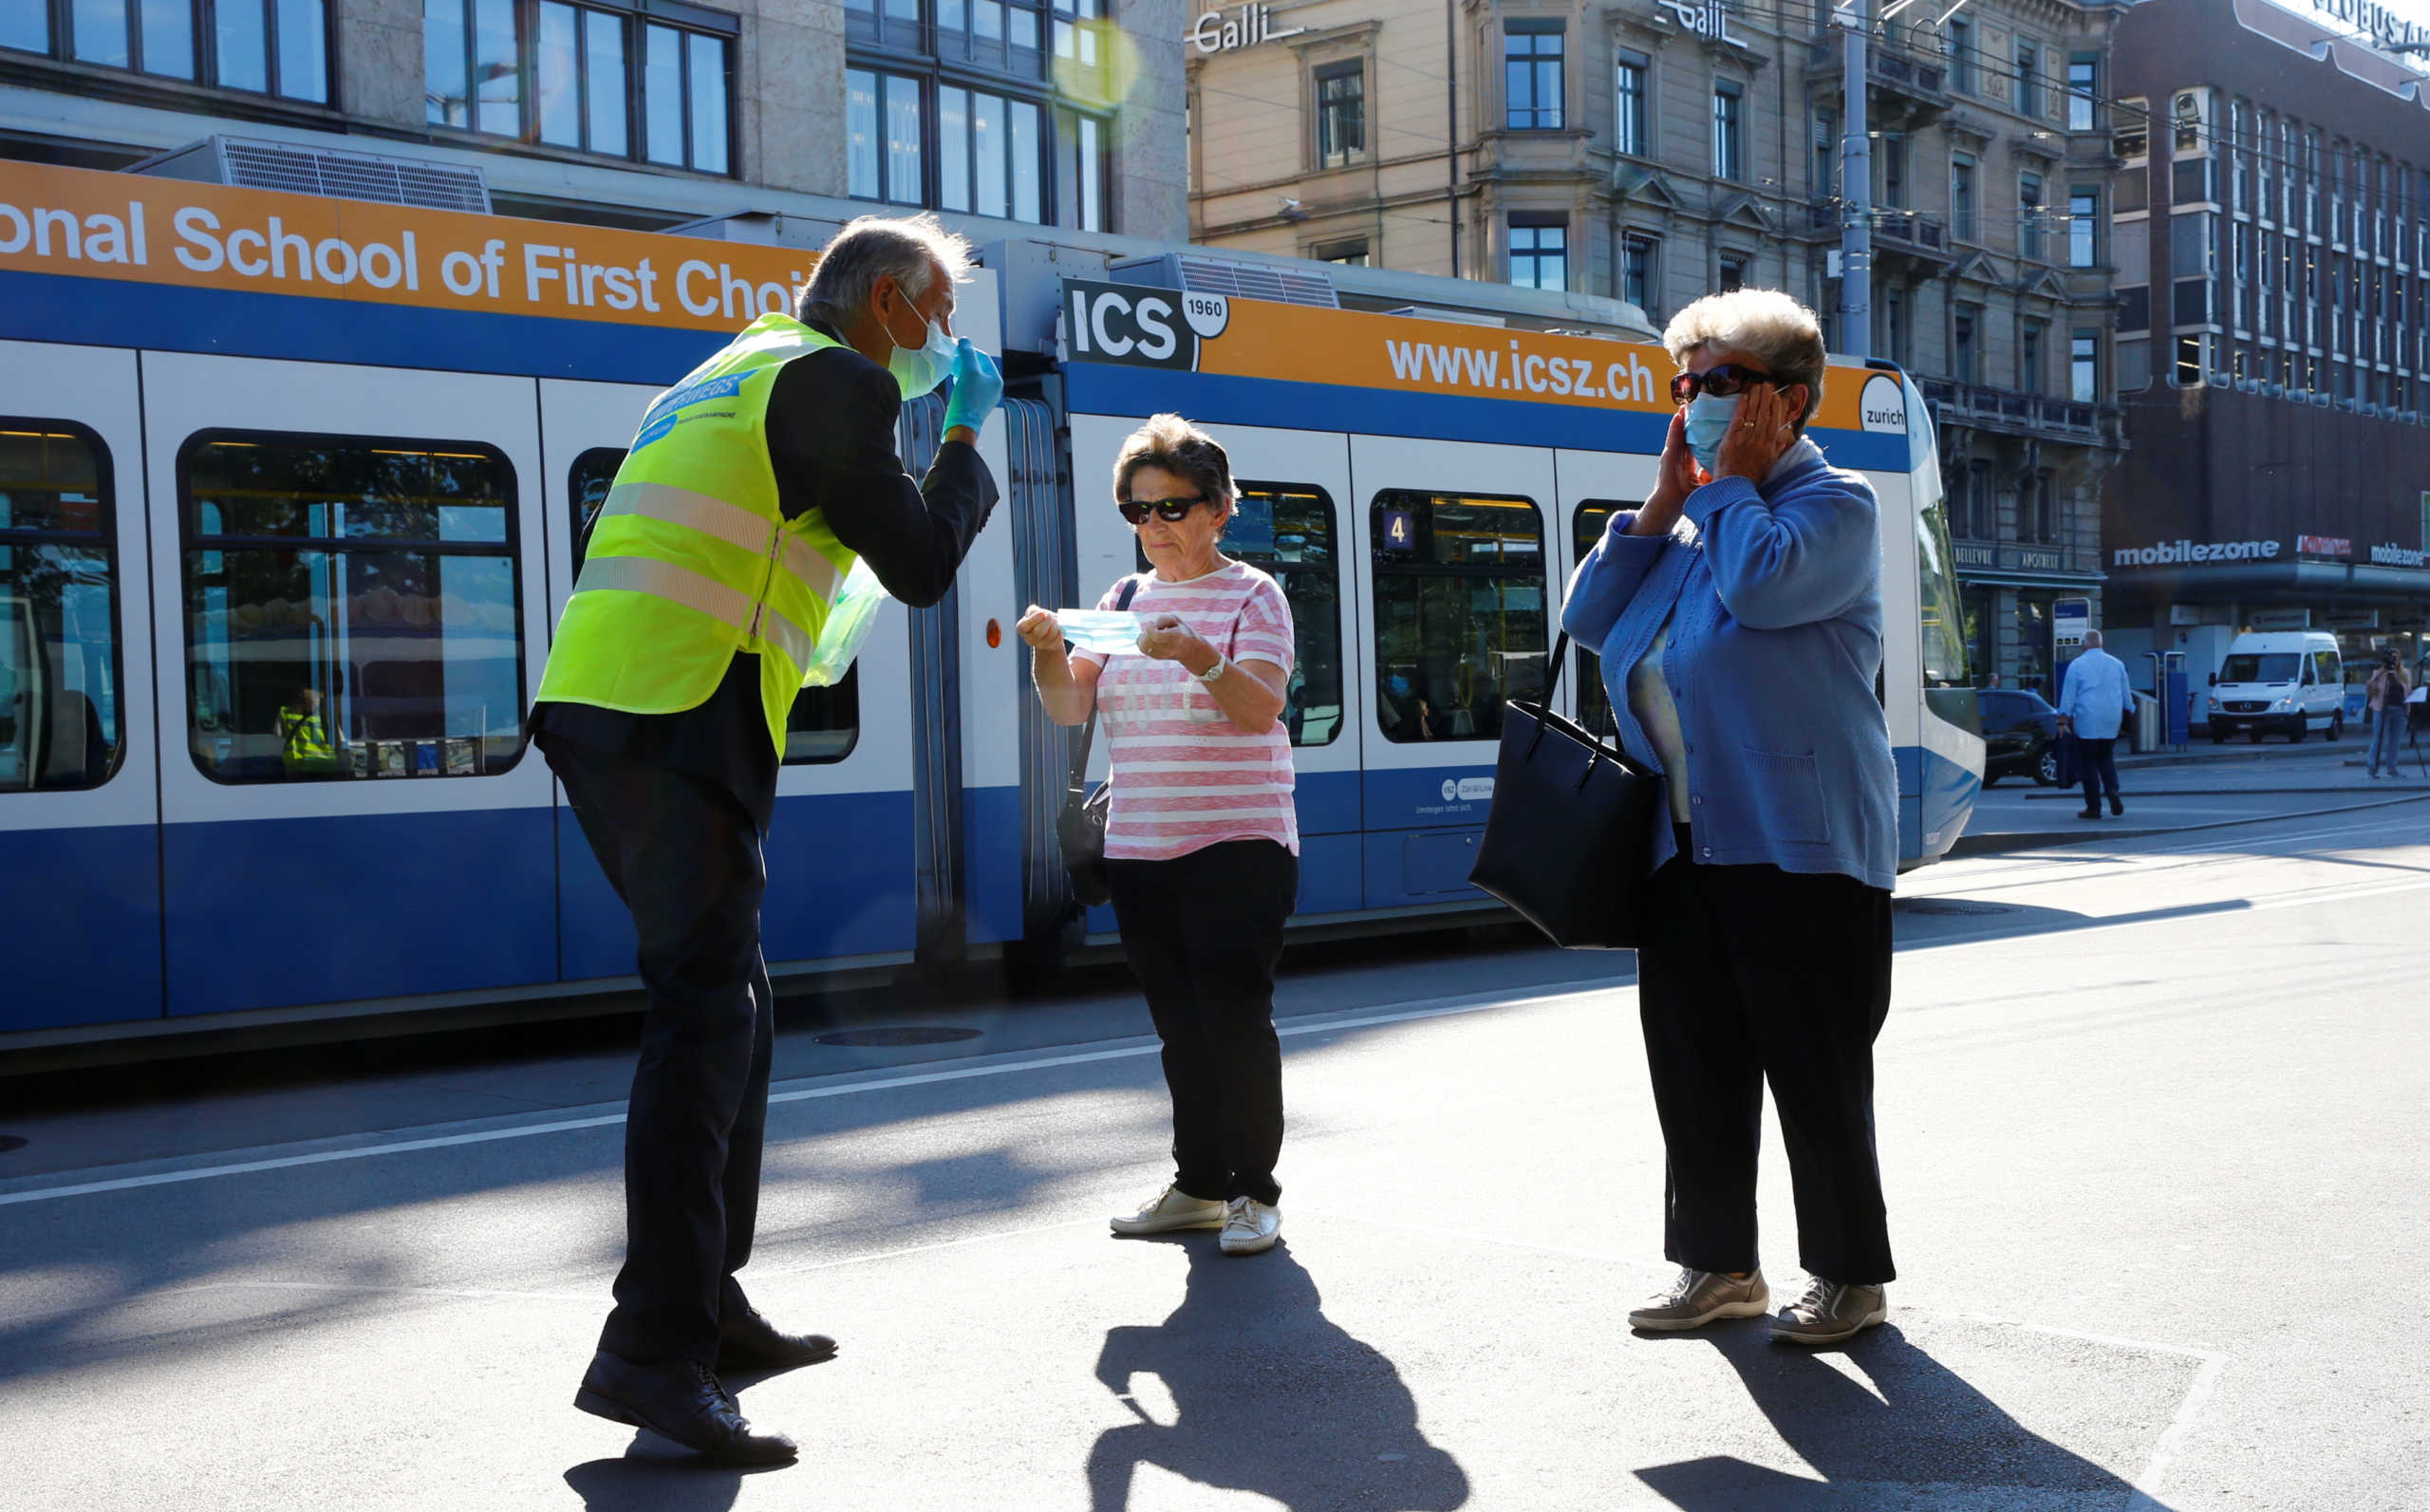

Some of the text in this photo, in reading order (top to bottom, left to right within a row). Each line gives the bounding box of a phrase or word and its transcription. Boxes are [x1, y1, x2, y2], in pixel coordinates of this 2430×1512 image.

[1194, 3, 1304, 53] Galli
[0, 200, 148, 266] onal
[173, 206, 419, 290] School
[440, 239, 504, 298] of
[523, 244, 660, 313] First
[1188, 299, 1223, 317] 1960
[1072, 289, 1177, 360] ICS
[1386, 339, 1655, 403] www.icsz.ch
[1867, 407, 1905, 426] zurich
[1391, 516, 1405, 543] 4
[1955, 547, 1992, 566] BELLEVUE
[2114, 539, 2280, 567] mobilezone
[2370, 541, 2424, 567] mobilezone
